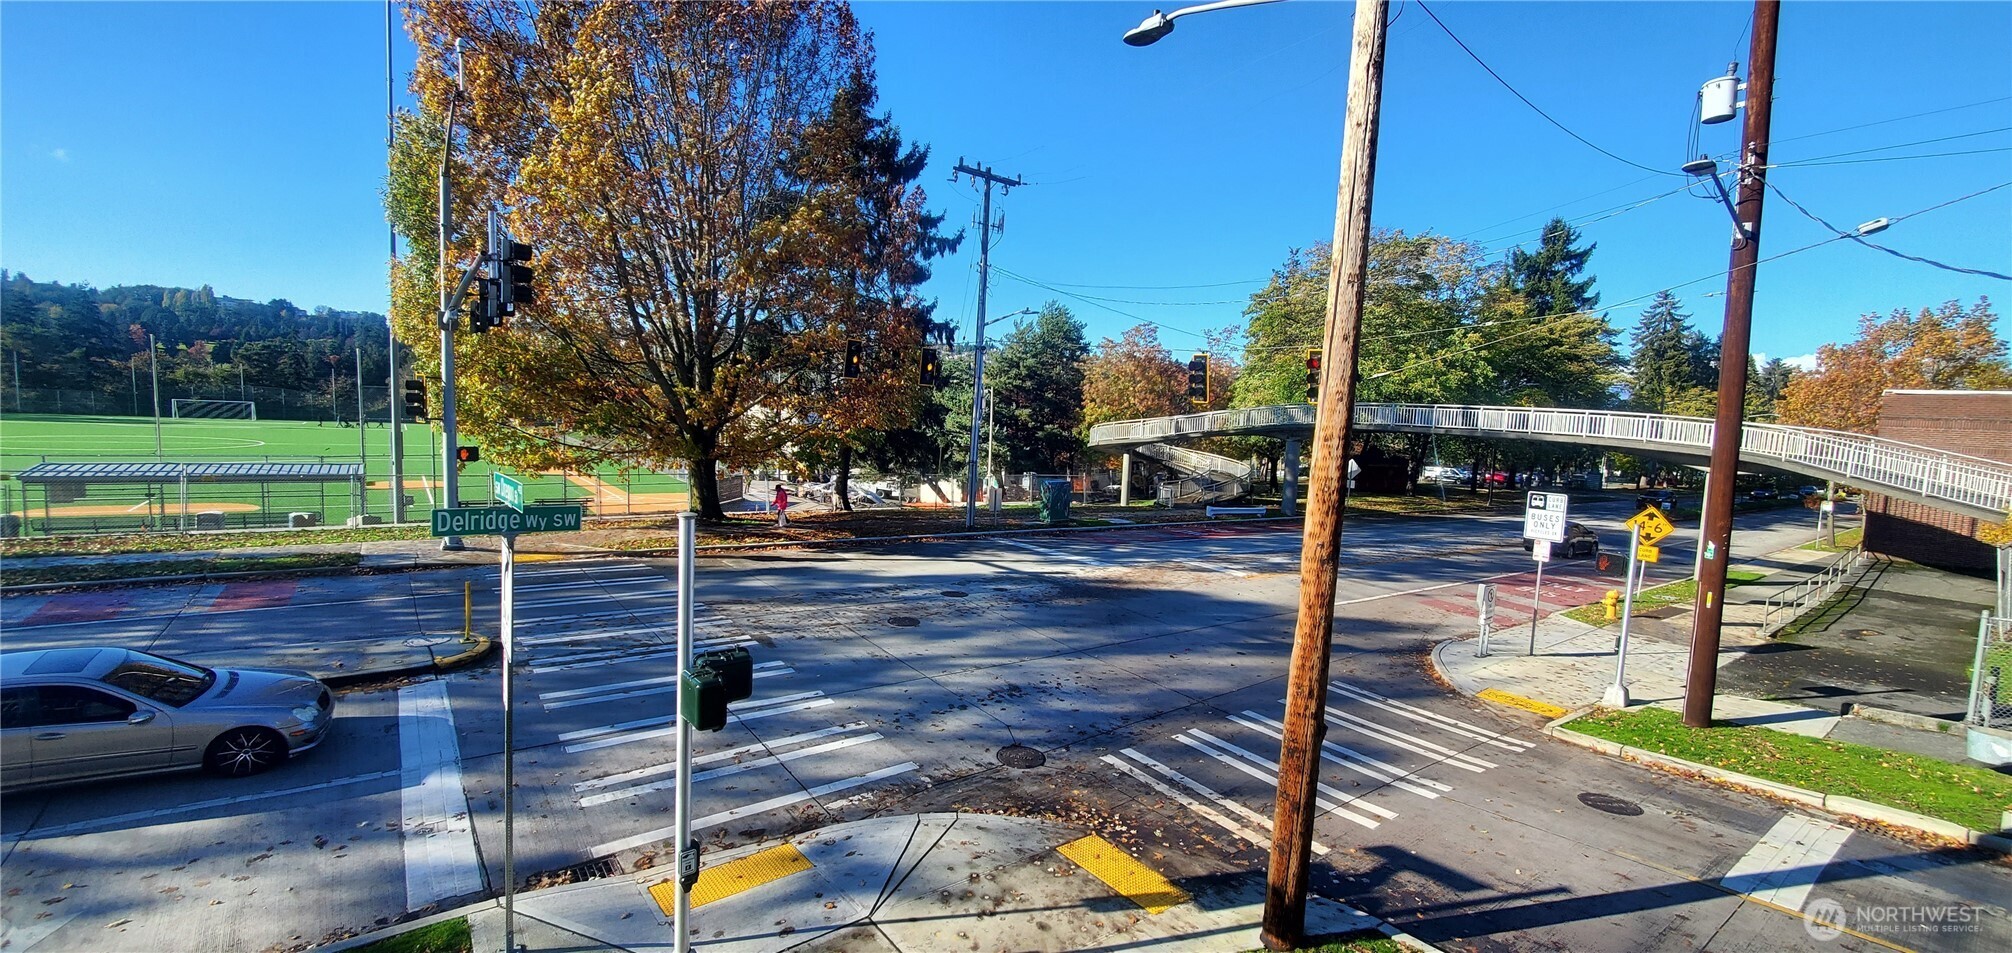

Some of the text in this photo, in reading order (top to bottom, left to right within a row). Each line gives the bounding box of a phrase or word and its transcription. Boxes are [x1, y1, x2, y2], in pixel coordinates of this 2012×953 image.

[437, 510, 576, 532] Delridge Wy SW
[1531, 513, 1560, 523] BUSES
[1533, 521, 1556, 530] ONLY
